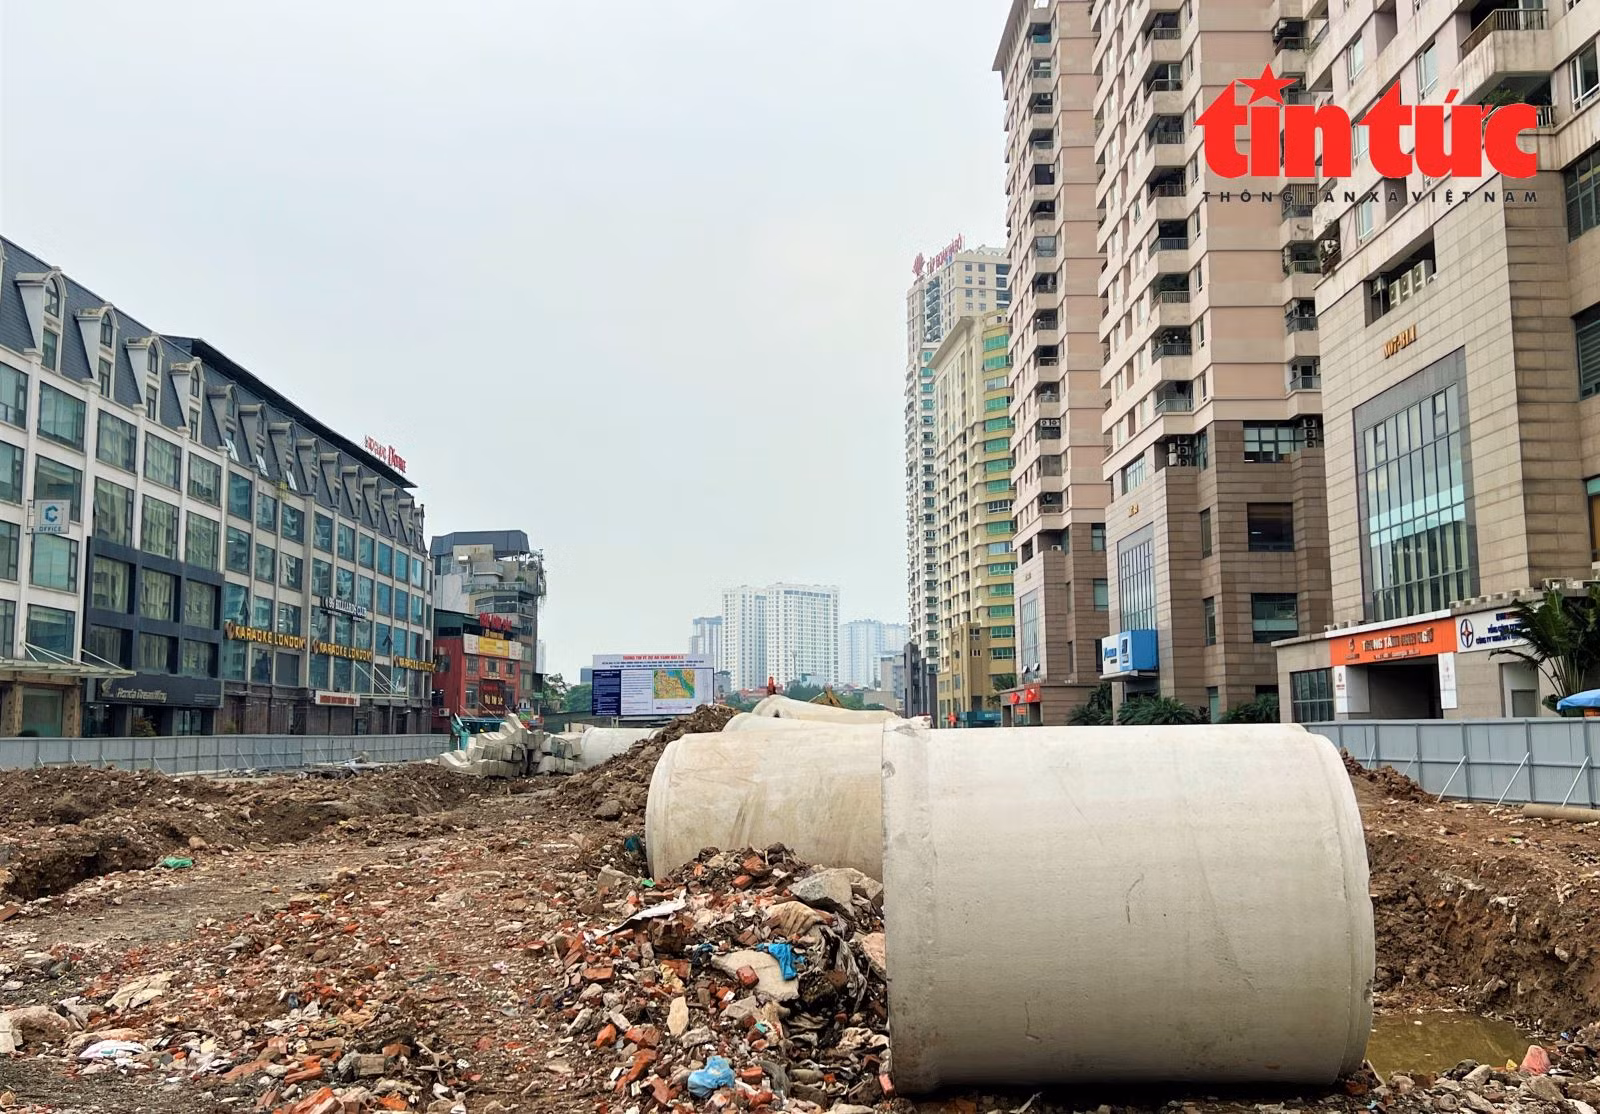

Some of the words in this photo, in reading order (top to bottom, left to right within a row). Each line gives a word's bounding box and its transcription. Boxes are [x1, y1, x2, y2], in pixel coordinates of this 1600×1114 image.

[235, 626, 273, 644] KARAOKE
[274, 631, 306, 649] LONDON
[320, 642, 347, 656] KARAOKE
